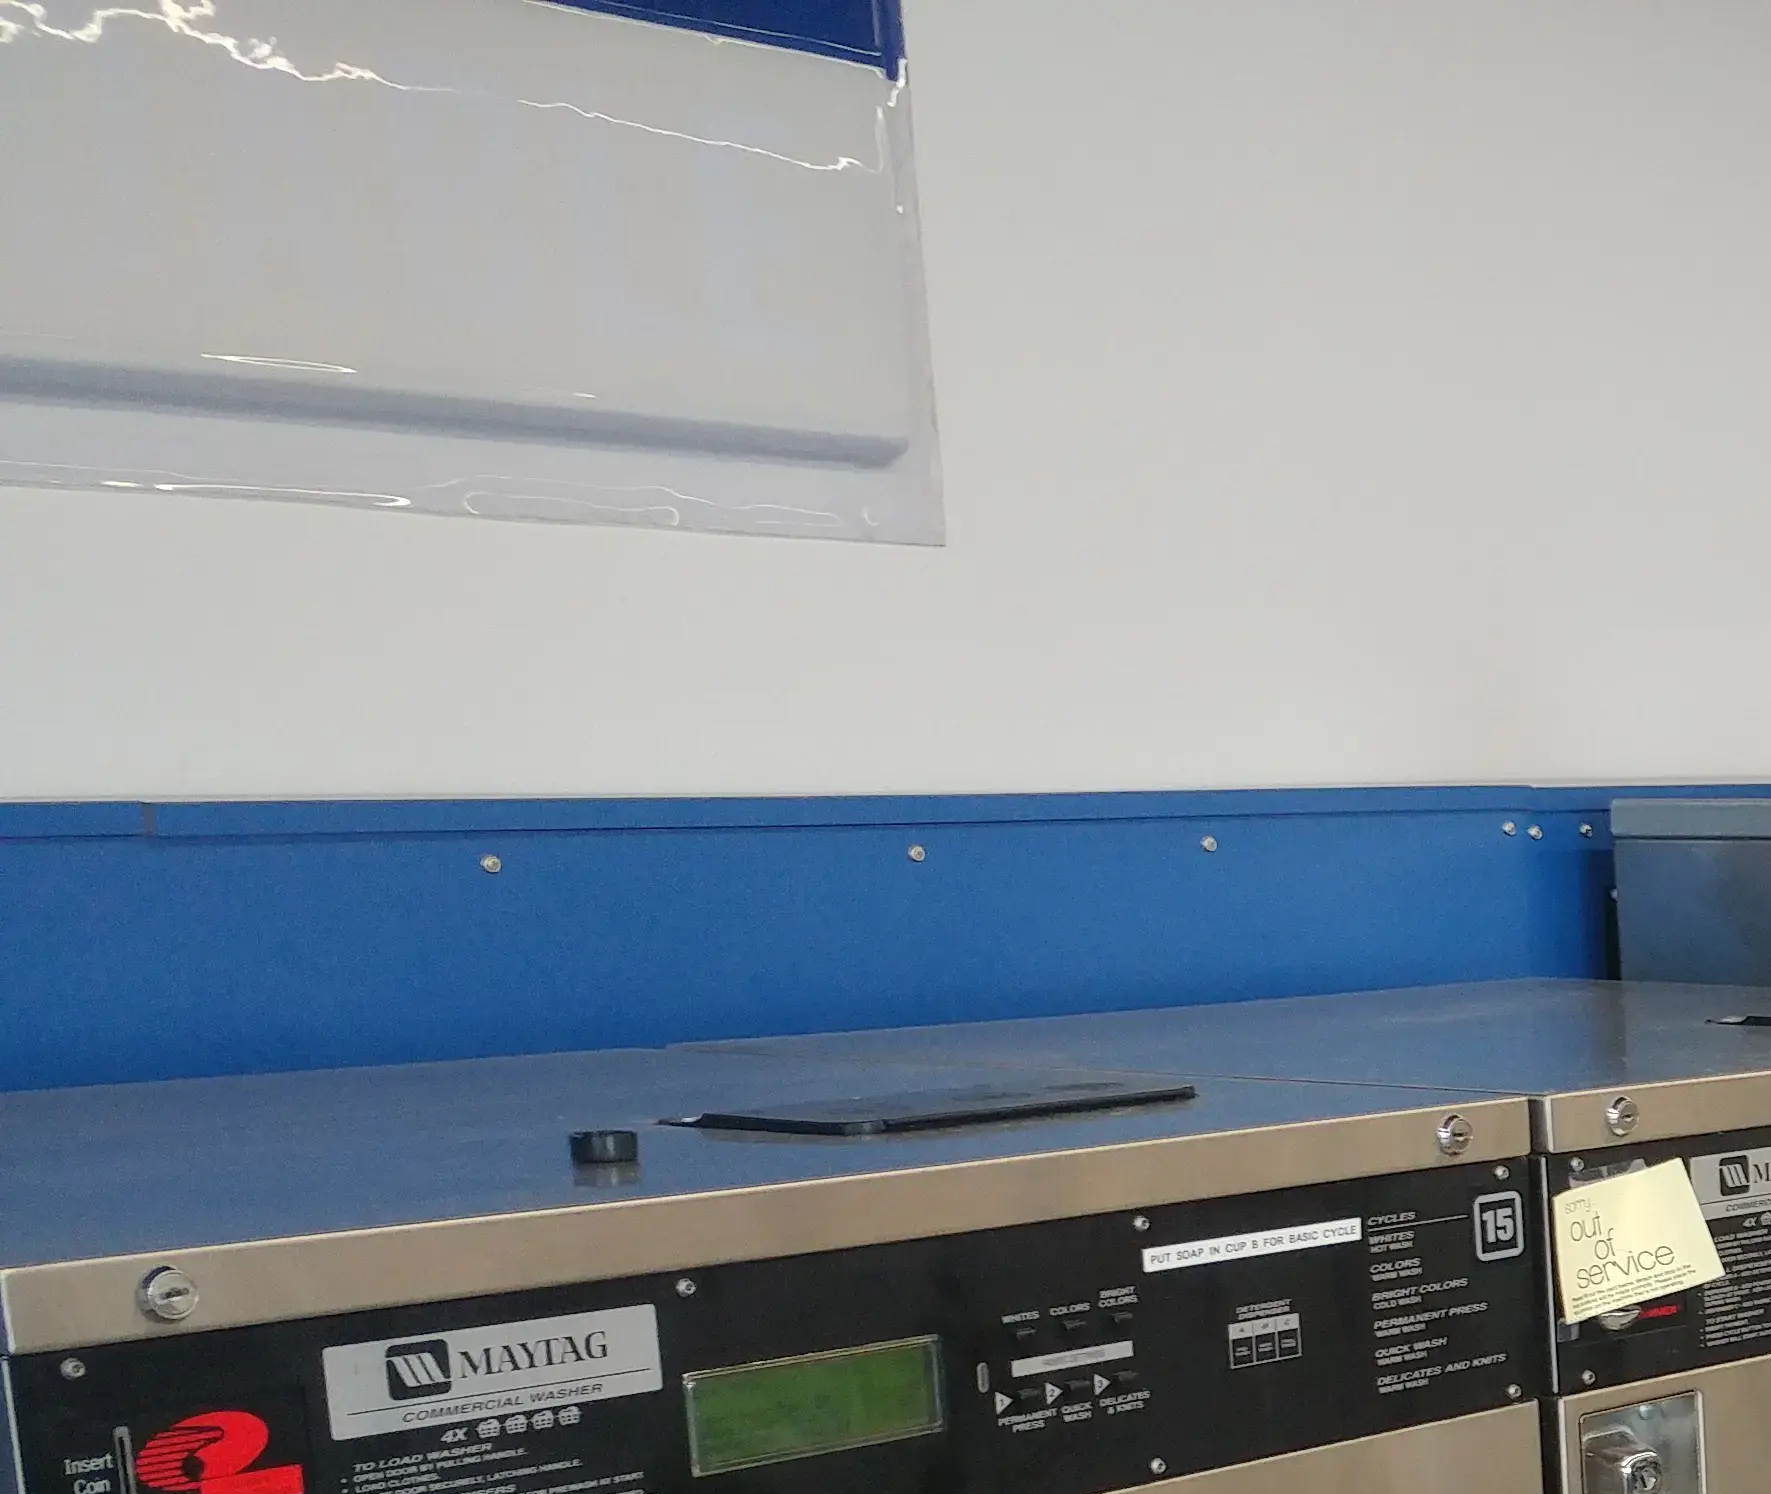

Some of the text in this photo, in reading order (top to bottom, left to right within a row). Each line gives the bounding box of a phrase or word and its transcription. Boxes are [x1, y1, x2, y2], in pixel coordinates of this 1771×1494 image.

[1367, 1211, 1417, 1227] CYCLES
[1482, 1207, 1515, 1243] 15
[1570, 1210, 1602, 1241] out
[1150, 1225, 1357, 1265] PUT SOAP IN CUP B FOR BASIC CYCLE
[1368, 1230, 1415, 1245] WHITES
[1594, 1228, 1616, 1260] of
[1369, 1258, 1422, 1274] COLORS
[1577, 1245, 1675, 1289] service
[1100, 1286, 1136, 1299] BRIGHT
[1371, 1277, 1469, 1302] BRIGHT COLORS
[1050, 1302, 1091, 1316] COLORS
[1098, 1294, 1139, 1308] COLORS
[1373, 1299, 1397, 1310] COLD
[1373, 1302, 1489, 1330] PERMANENT PRESS
[458, 1330, 608, 1380] MAYTAG
[1374, 1337, 1448, 1358] QUICK WASH
[1376, 1353, 1508, 1386] DELICATES AND KNITS
[401, 1383, 604, 1424] COMMERCIAL WASHER
[1100, 1390, 1151, 1407] DELICATES
[998, 1408, 1058, 1426] PERMANENT
[1012, 1420, 1046, 1433] PRESS
[1063, 1411, 1092, 1423] WASH
[440, 1427, 468, 1443] 4X
[63, 1452, 115, 1475] Insert
[353, 1443, 492, 1472] TO LOAD WASHER
